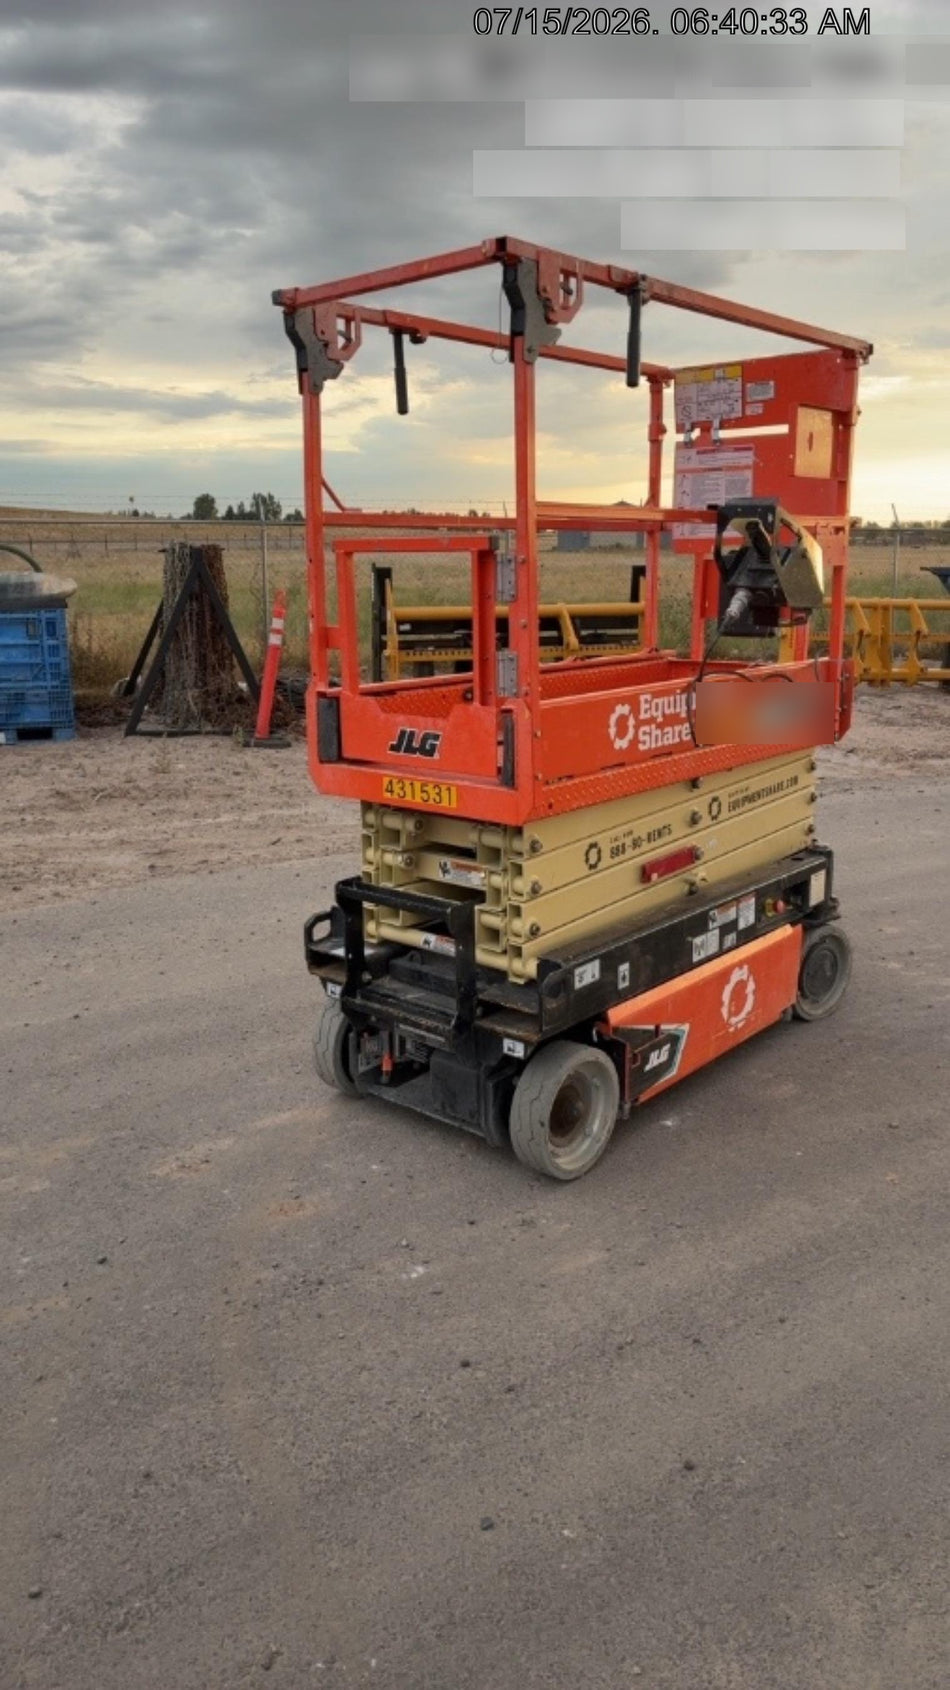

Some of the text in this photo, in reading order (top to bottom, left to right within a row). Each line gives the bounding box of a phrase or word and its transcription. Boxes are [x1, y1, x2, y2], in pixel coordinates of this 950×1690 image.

[639, 689, 697, 722] Equip
[387, 727, 441, 759] JLG
[638, 722, 691, 751] Share
[384, 778, 452, 806] 431531
